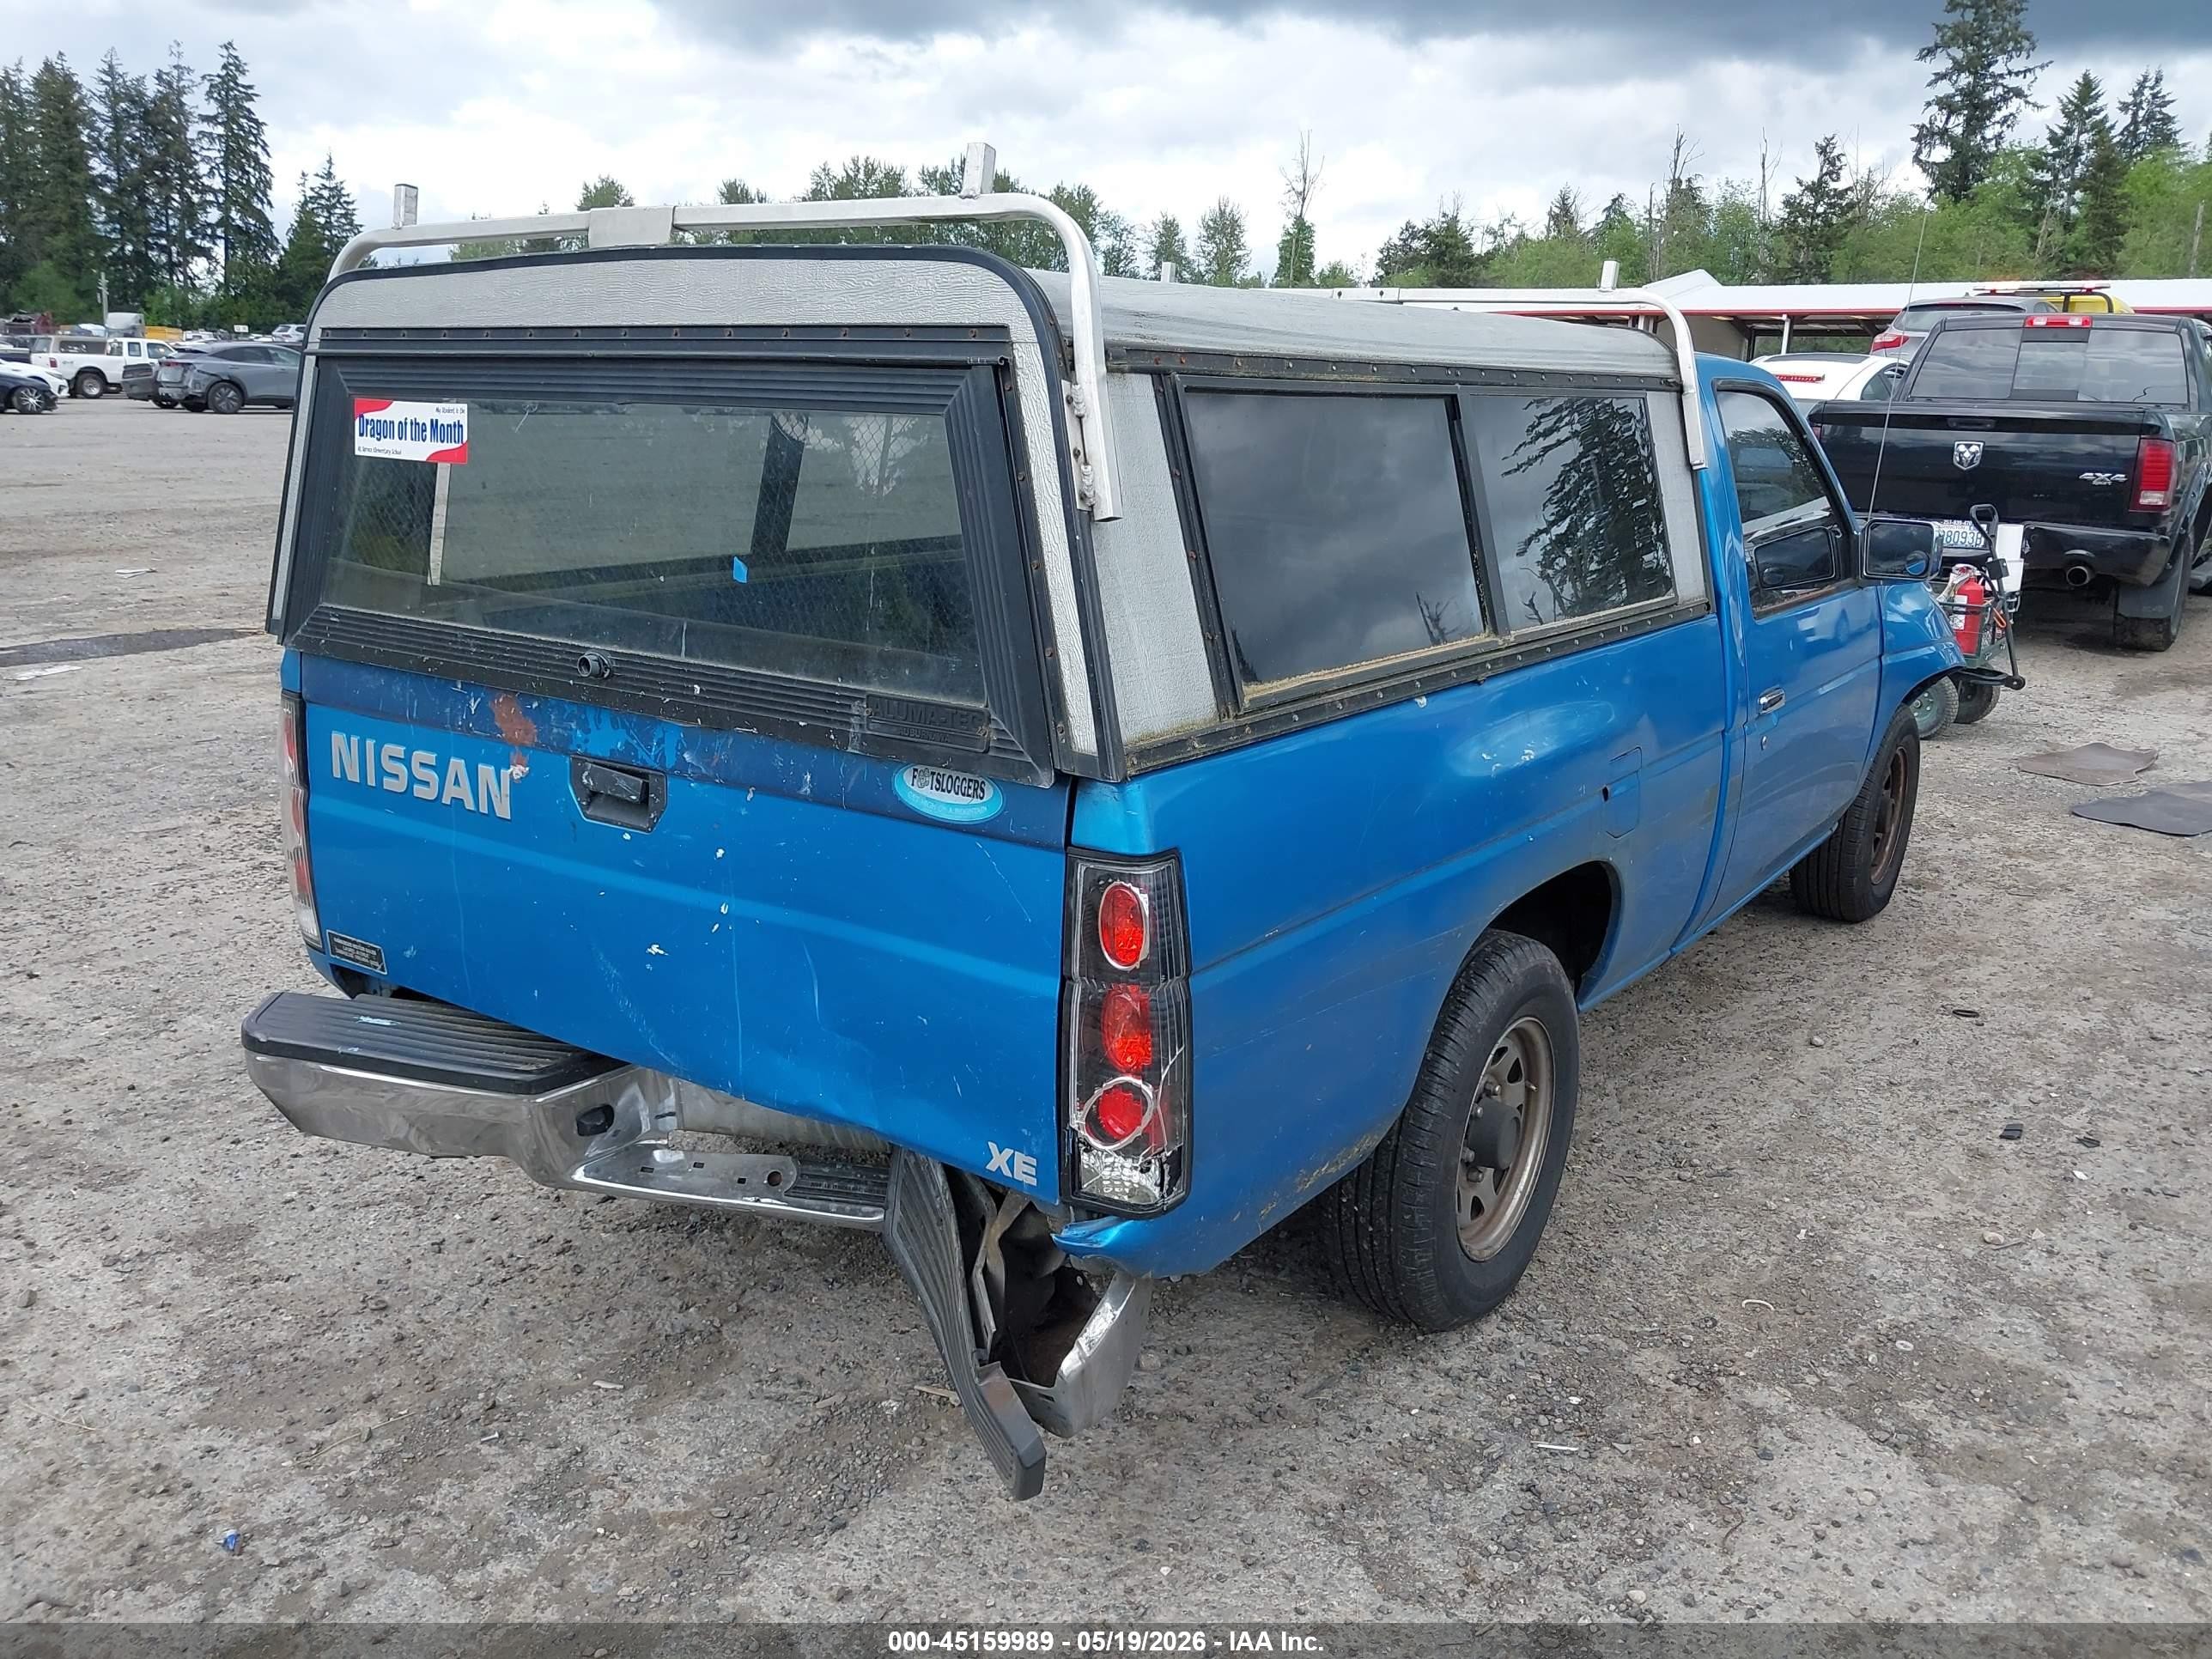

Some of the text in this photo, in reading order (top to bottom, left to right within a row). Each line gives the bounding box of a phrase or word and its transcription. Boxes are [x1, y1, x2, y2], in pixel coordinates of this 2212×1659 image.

[358, 414, 464, 445] Dragon of the Month
[331, 730, 512, 820] NISSAN
[985, 1140, 1037, 1187] XE
